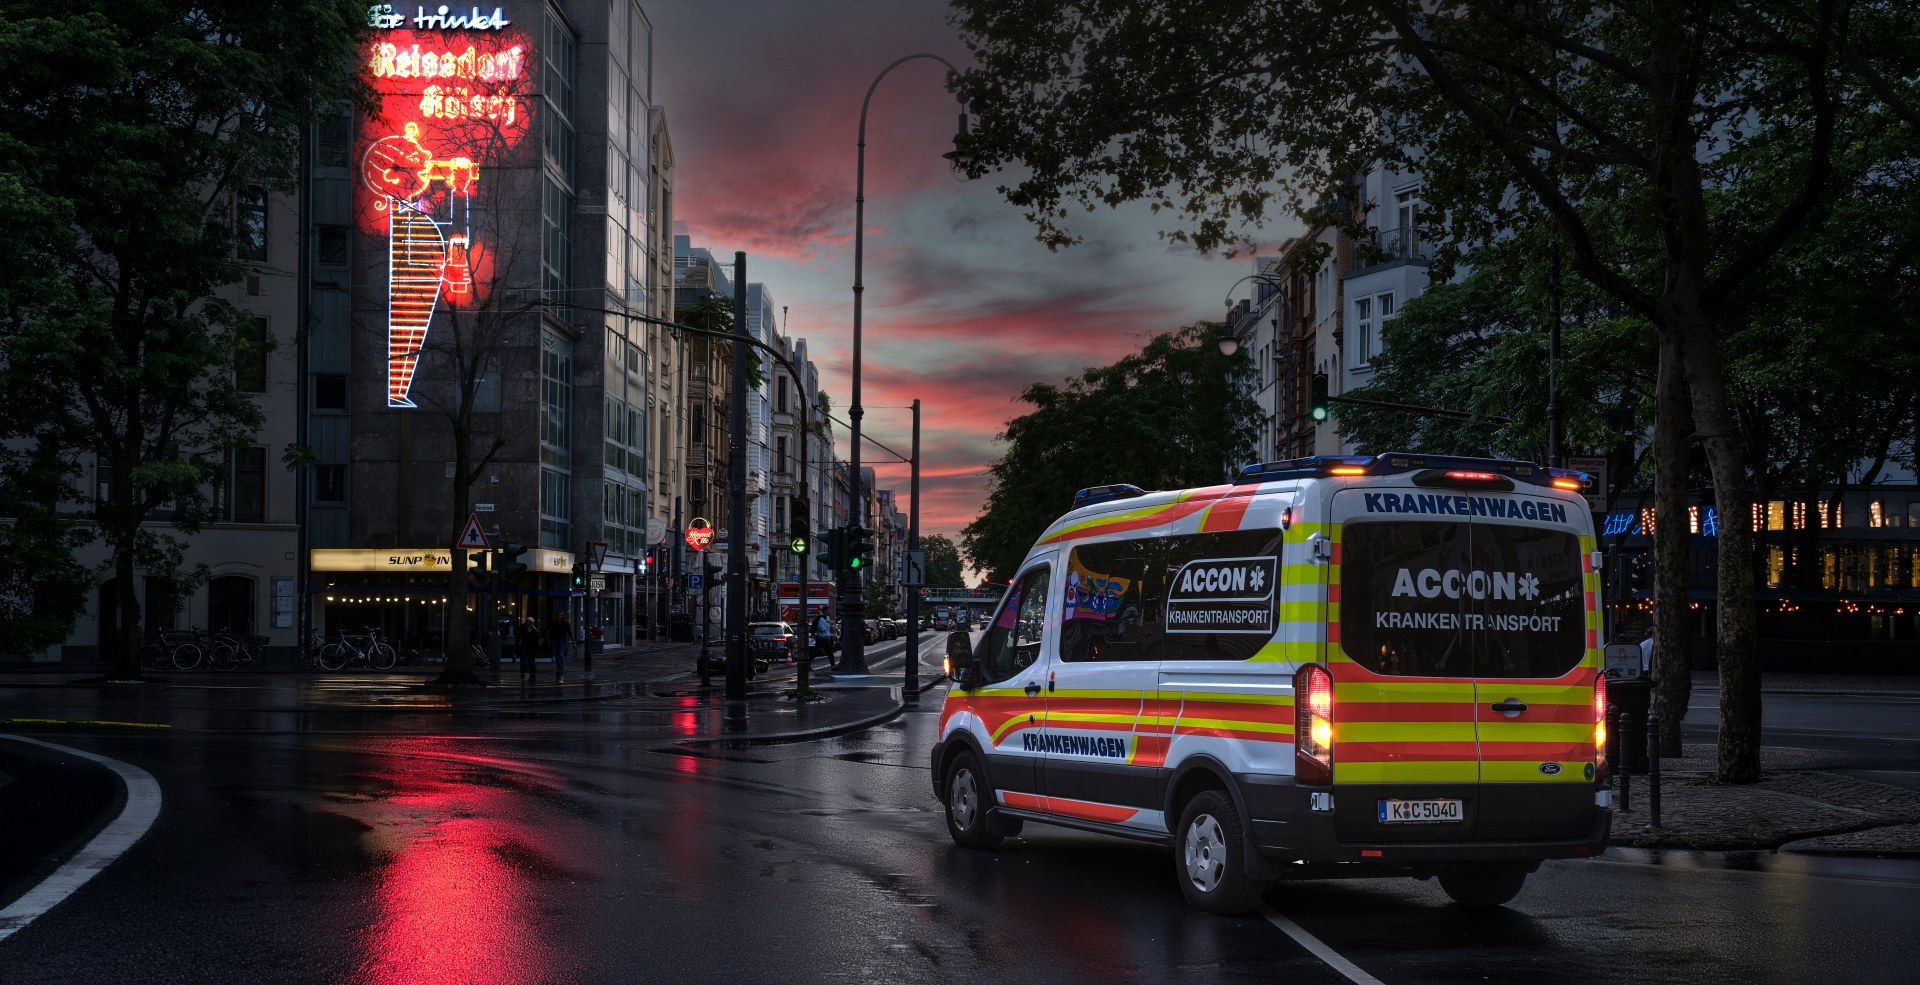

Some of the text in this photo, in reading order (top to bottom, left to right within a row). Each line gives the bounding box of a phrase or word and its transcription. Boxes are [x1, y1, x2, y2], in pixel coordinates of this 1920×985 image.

[414, 5, 511, 30] trinkt
[369, 42, 524, 80] Reissdorf
[1364, 493, 1567, 523] KRANKENWAGEN
[591, 580, 604, 589] IOSK
[1180, 567, 1247, 592] ACCON
[1391, 568, 1516, 600] ACCON
[1169, 609, 1269, 625] KRANKENTRANSPORT
[1376, 611, 1561, 632] KRANKENTRANSPORT
[1022, 732, 1126, 758] KRANKENWAGEN
[1423, 802, 1457, 818] 5040
